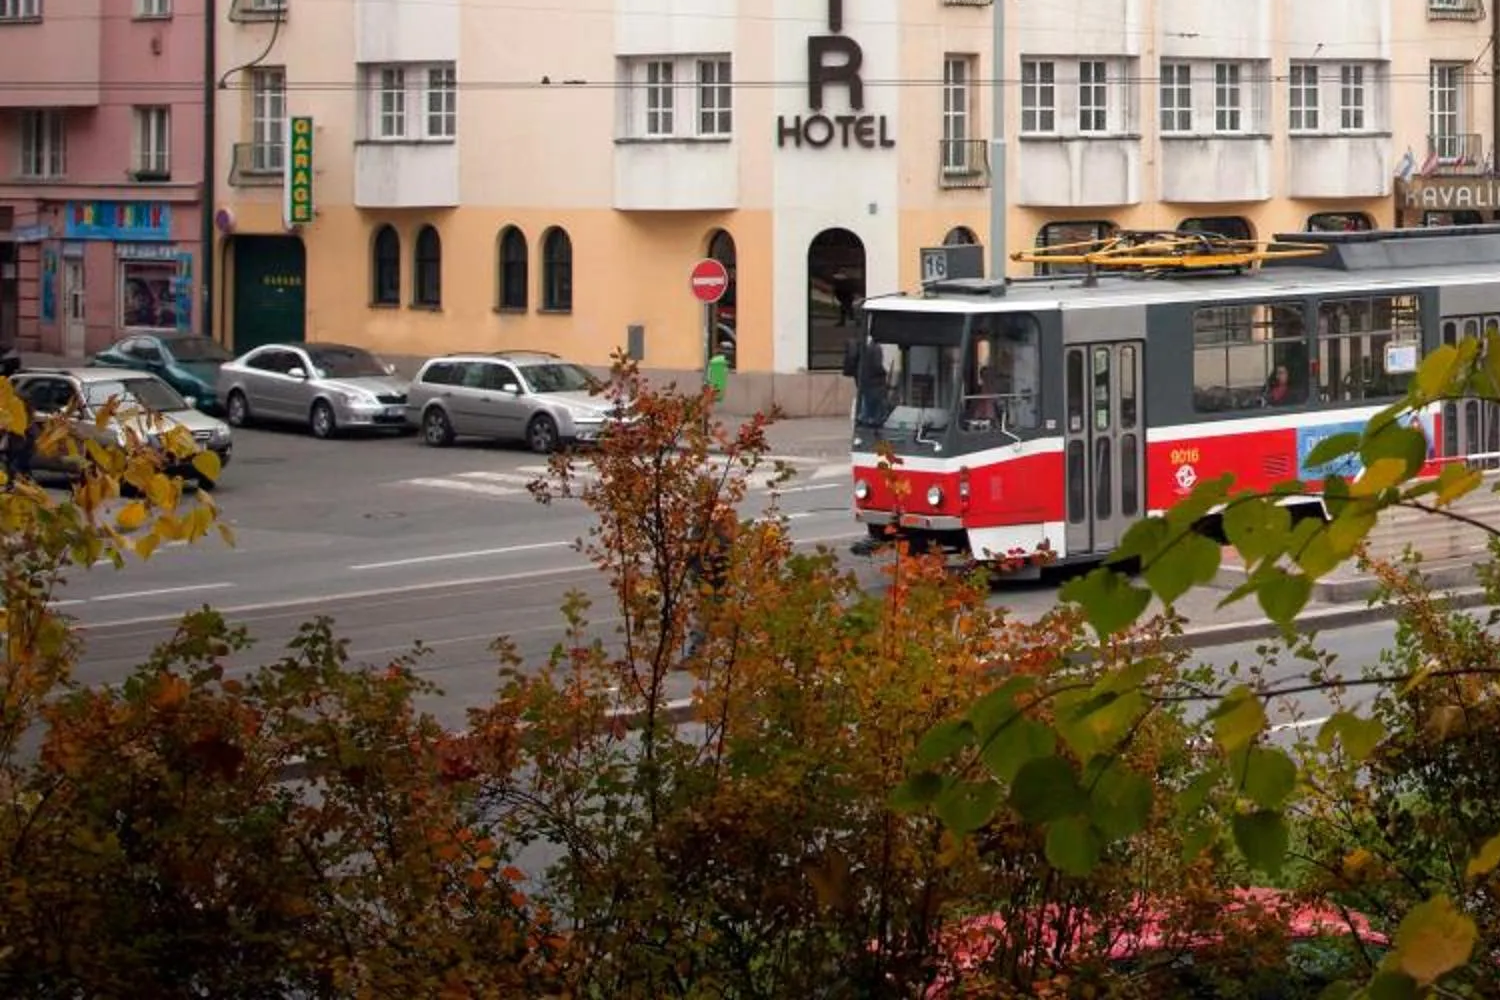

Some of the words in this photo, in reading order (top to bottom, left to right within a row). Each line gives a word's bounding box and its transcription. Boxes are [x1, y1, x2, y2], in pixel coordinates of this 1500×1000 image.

[777, 115, 895, 148] HOTEL
[294, 119, 309, 219] GARAGE
[925, 254, 945, 277] 16
[1170, 448, 1200, 465] 9016
